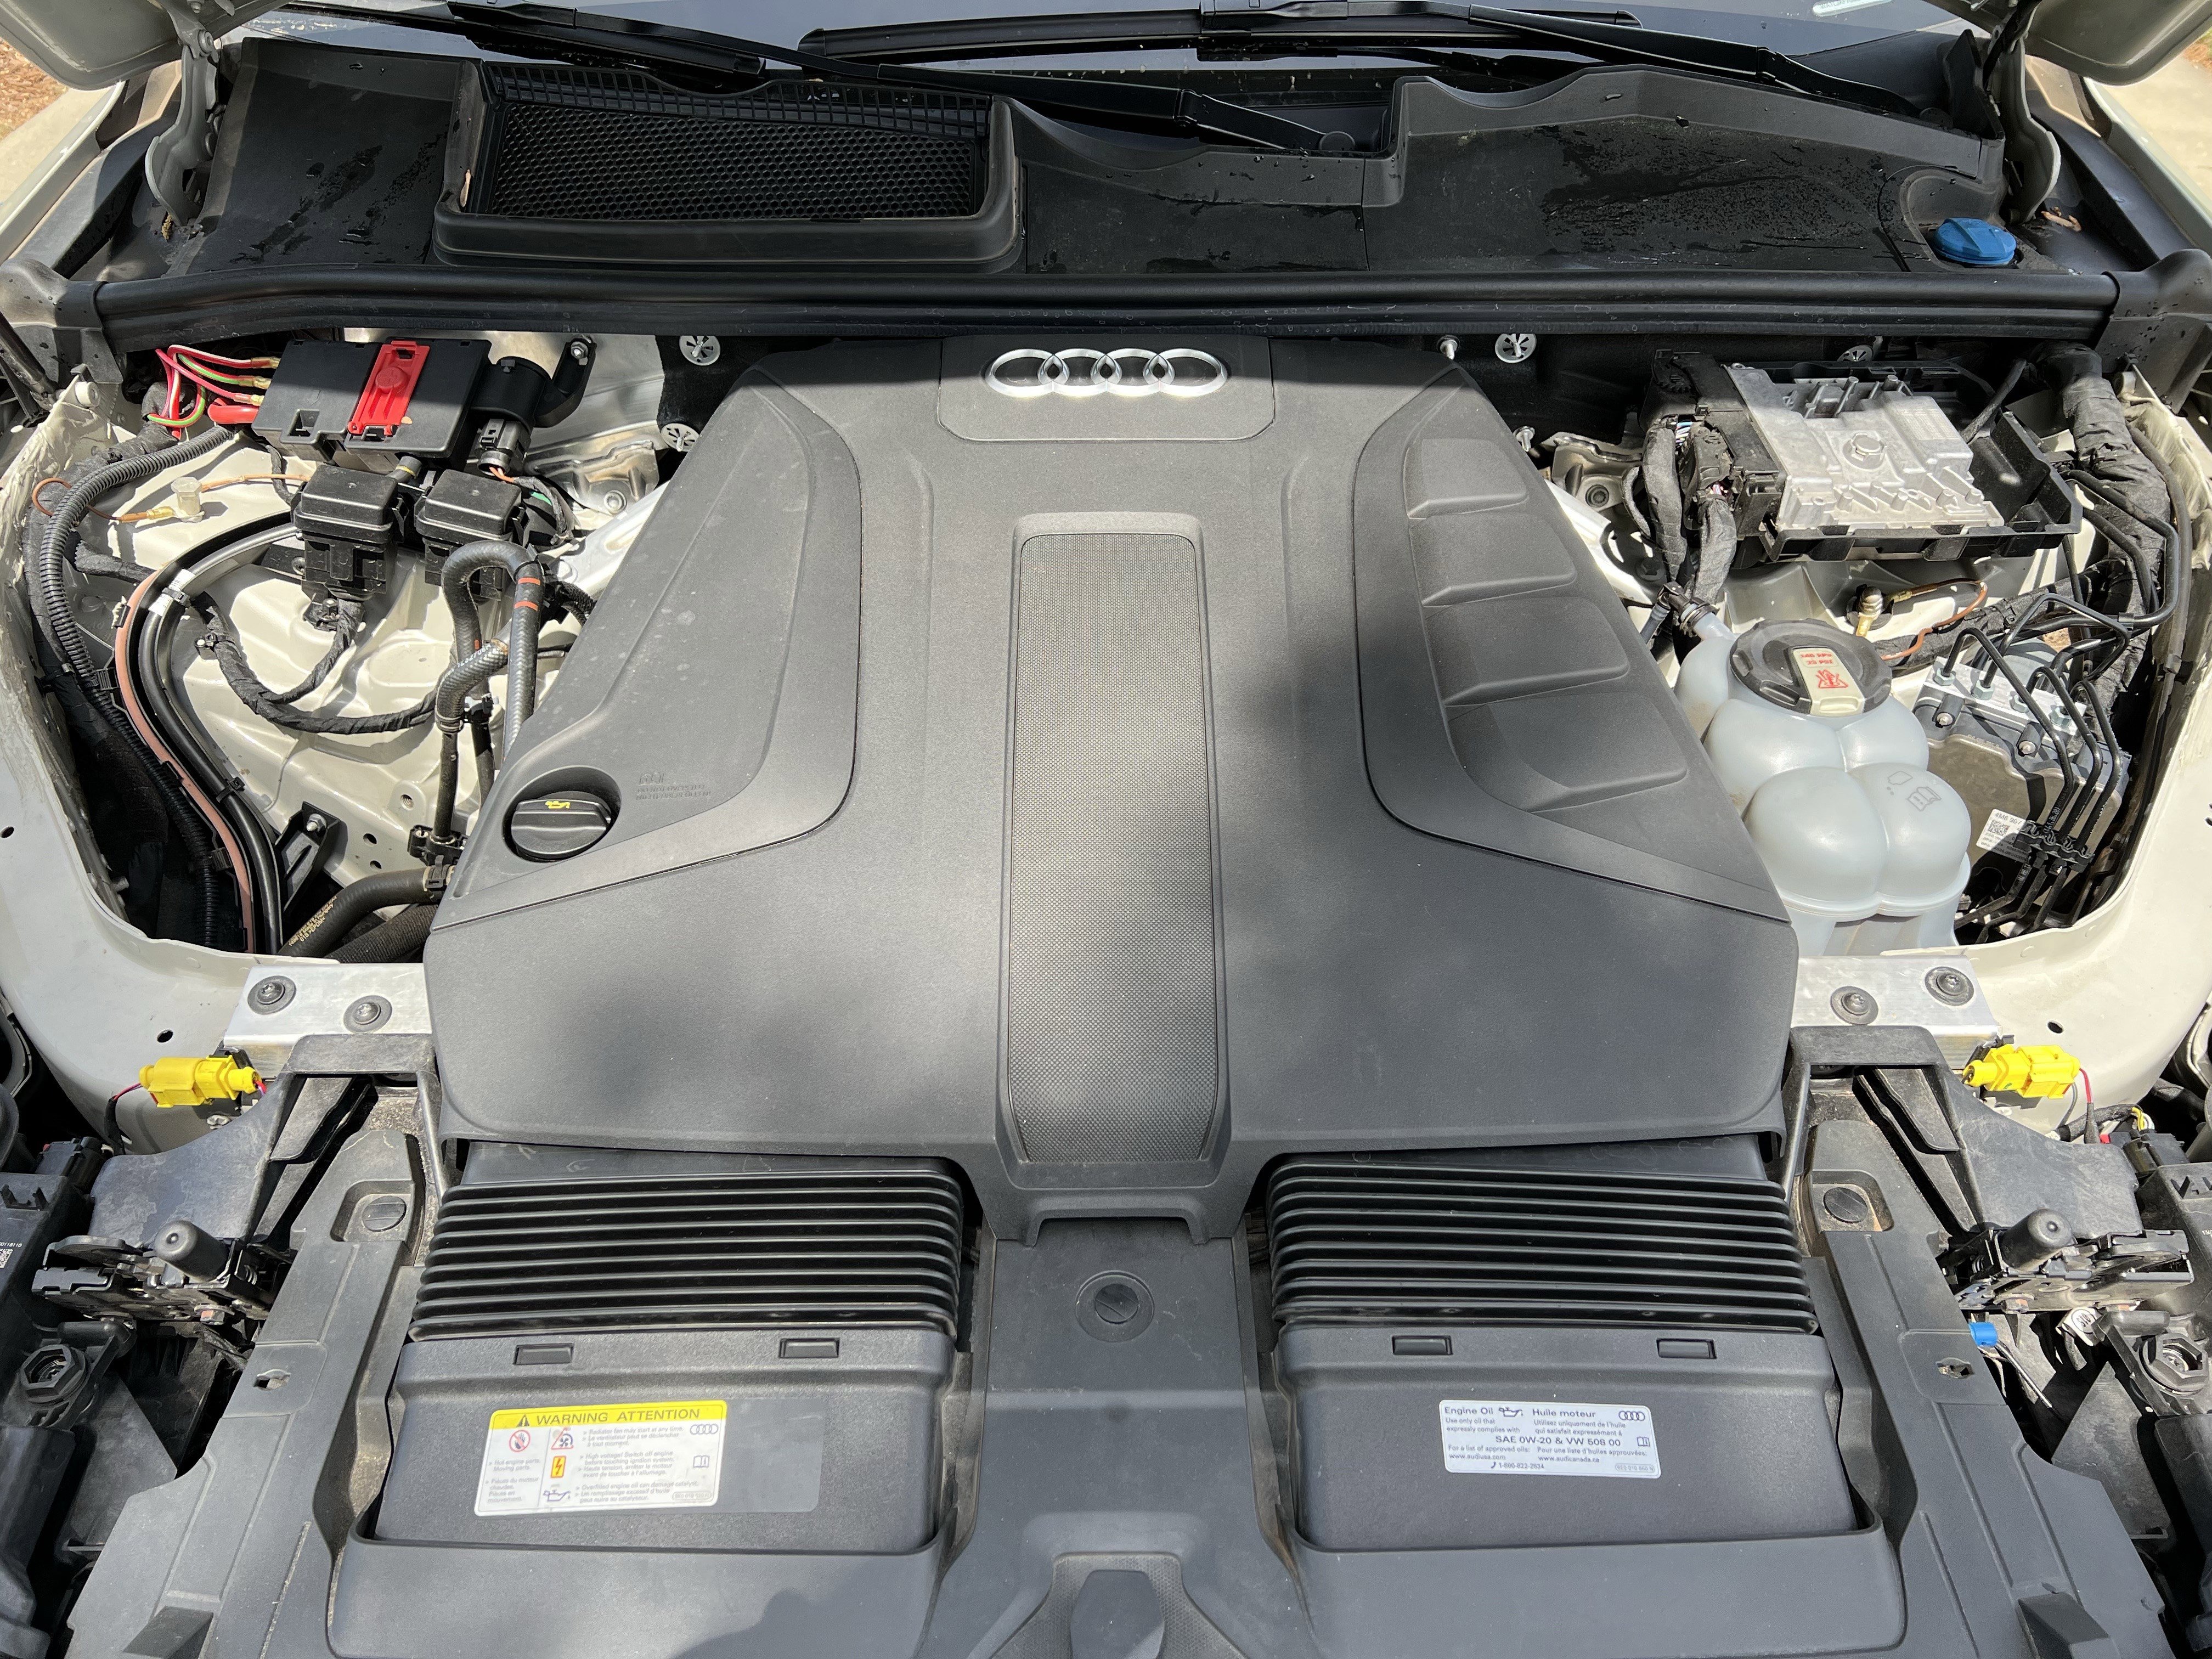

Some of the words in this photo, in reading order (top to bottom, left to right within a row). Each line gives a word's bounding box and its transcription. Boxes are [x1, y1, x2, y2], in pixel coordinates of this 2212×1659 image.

[537, 1412, 608, 1425] WARNING
[616, 1409, 701, 1421] ATTENTION
[1444, 1407, 1477, 1415] Engine
